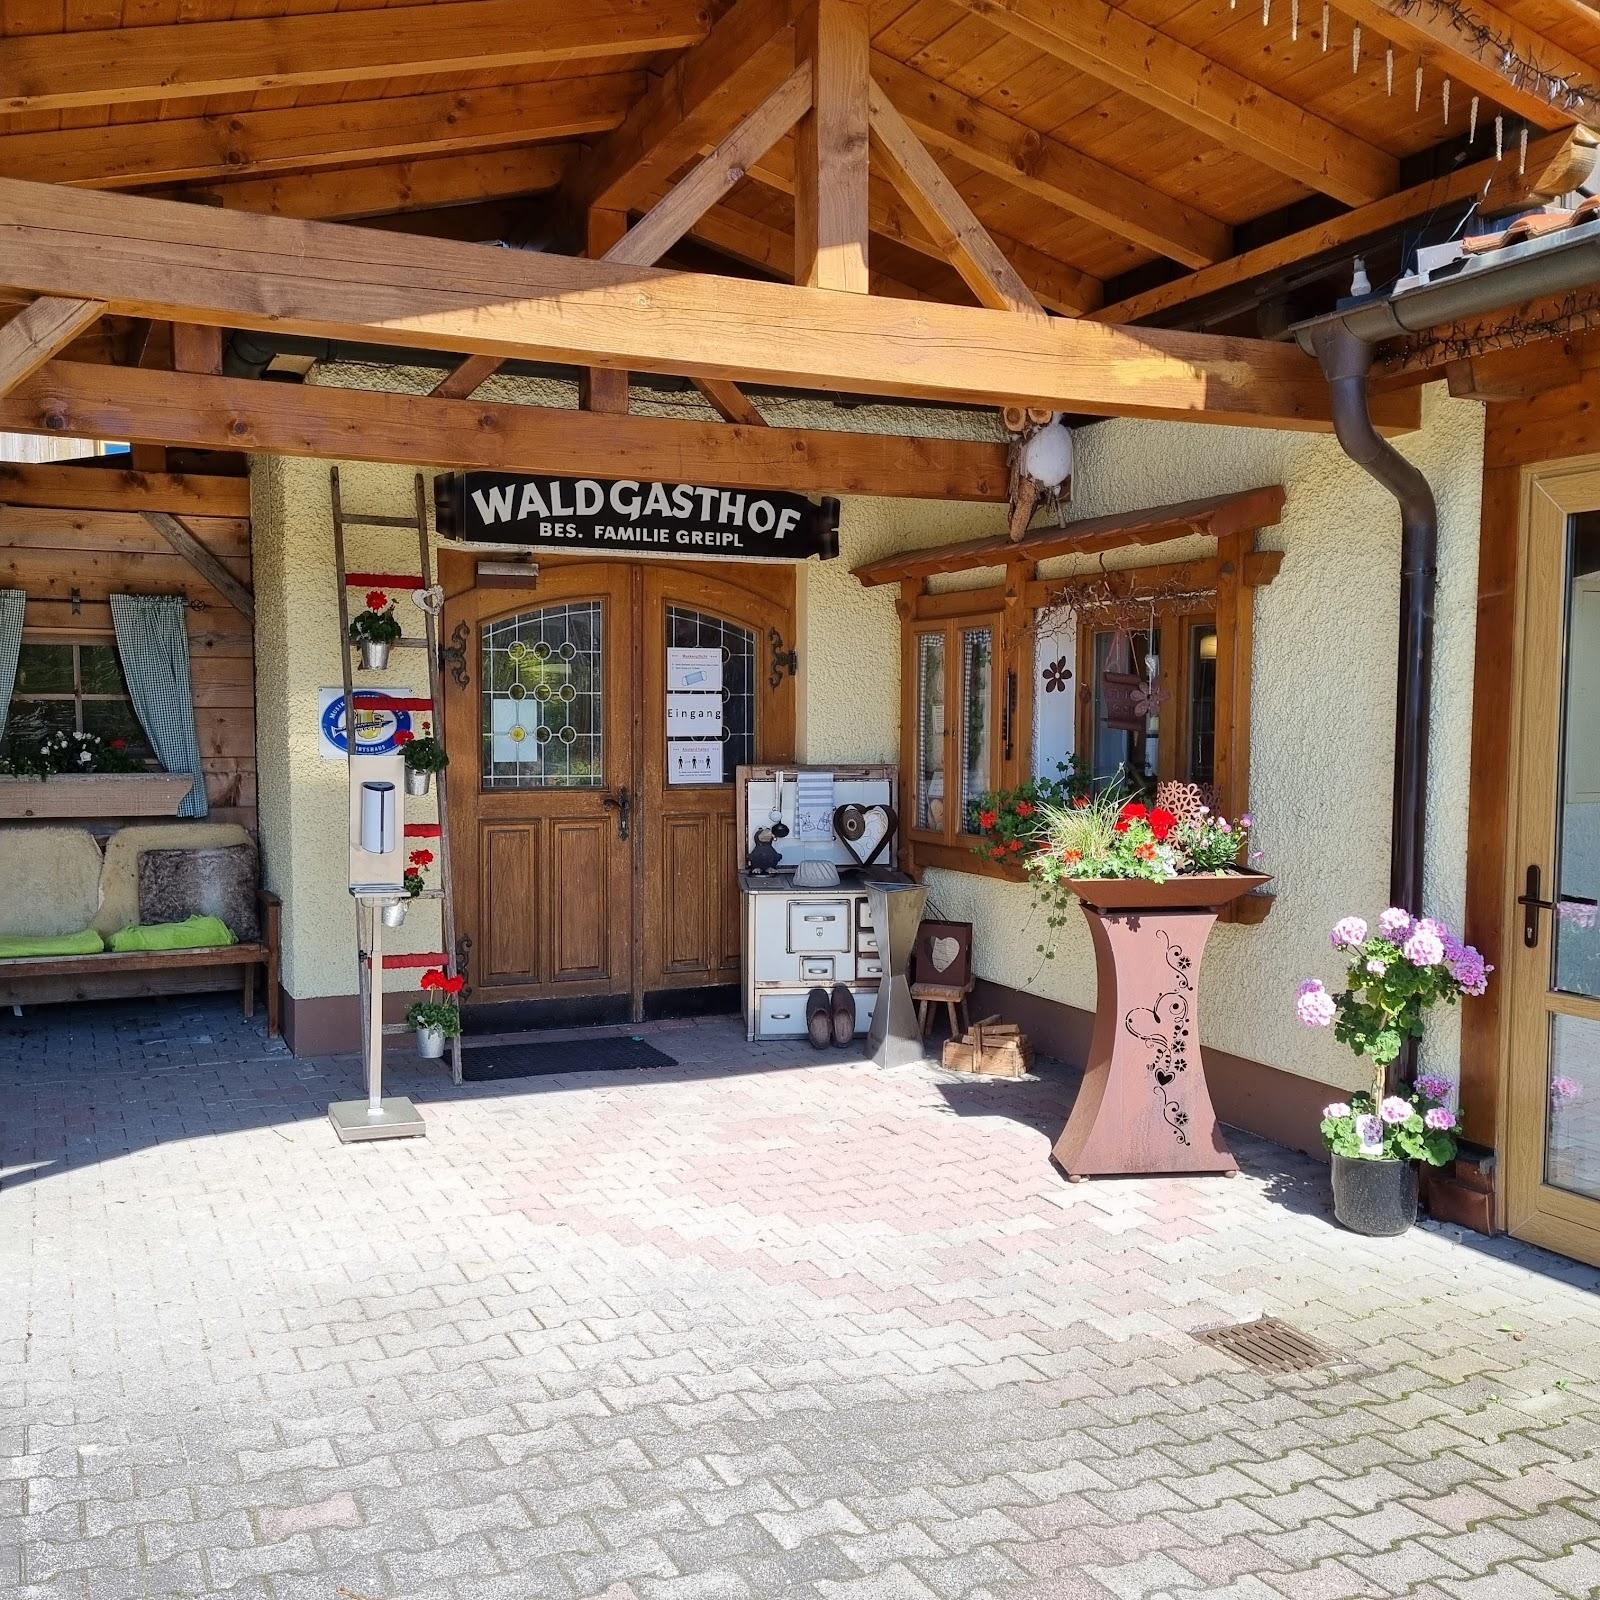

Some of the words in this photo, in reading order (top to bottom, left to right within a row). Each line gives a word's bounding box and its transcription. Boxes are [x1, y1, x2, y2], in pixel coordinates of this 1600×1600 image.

[471, 479, 801, 539] WALDGASTHOF
[539, 522, 583, 539] BES.
[594, 525, 670, 544] FAMILIE
[676, 529, 744, 549] GREIPL
[667, 708, 721, 719] Eingang
